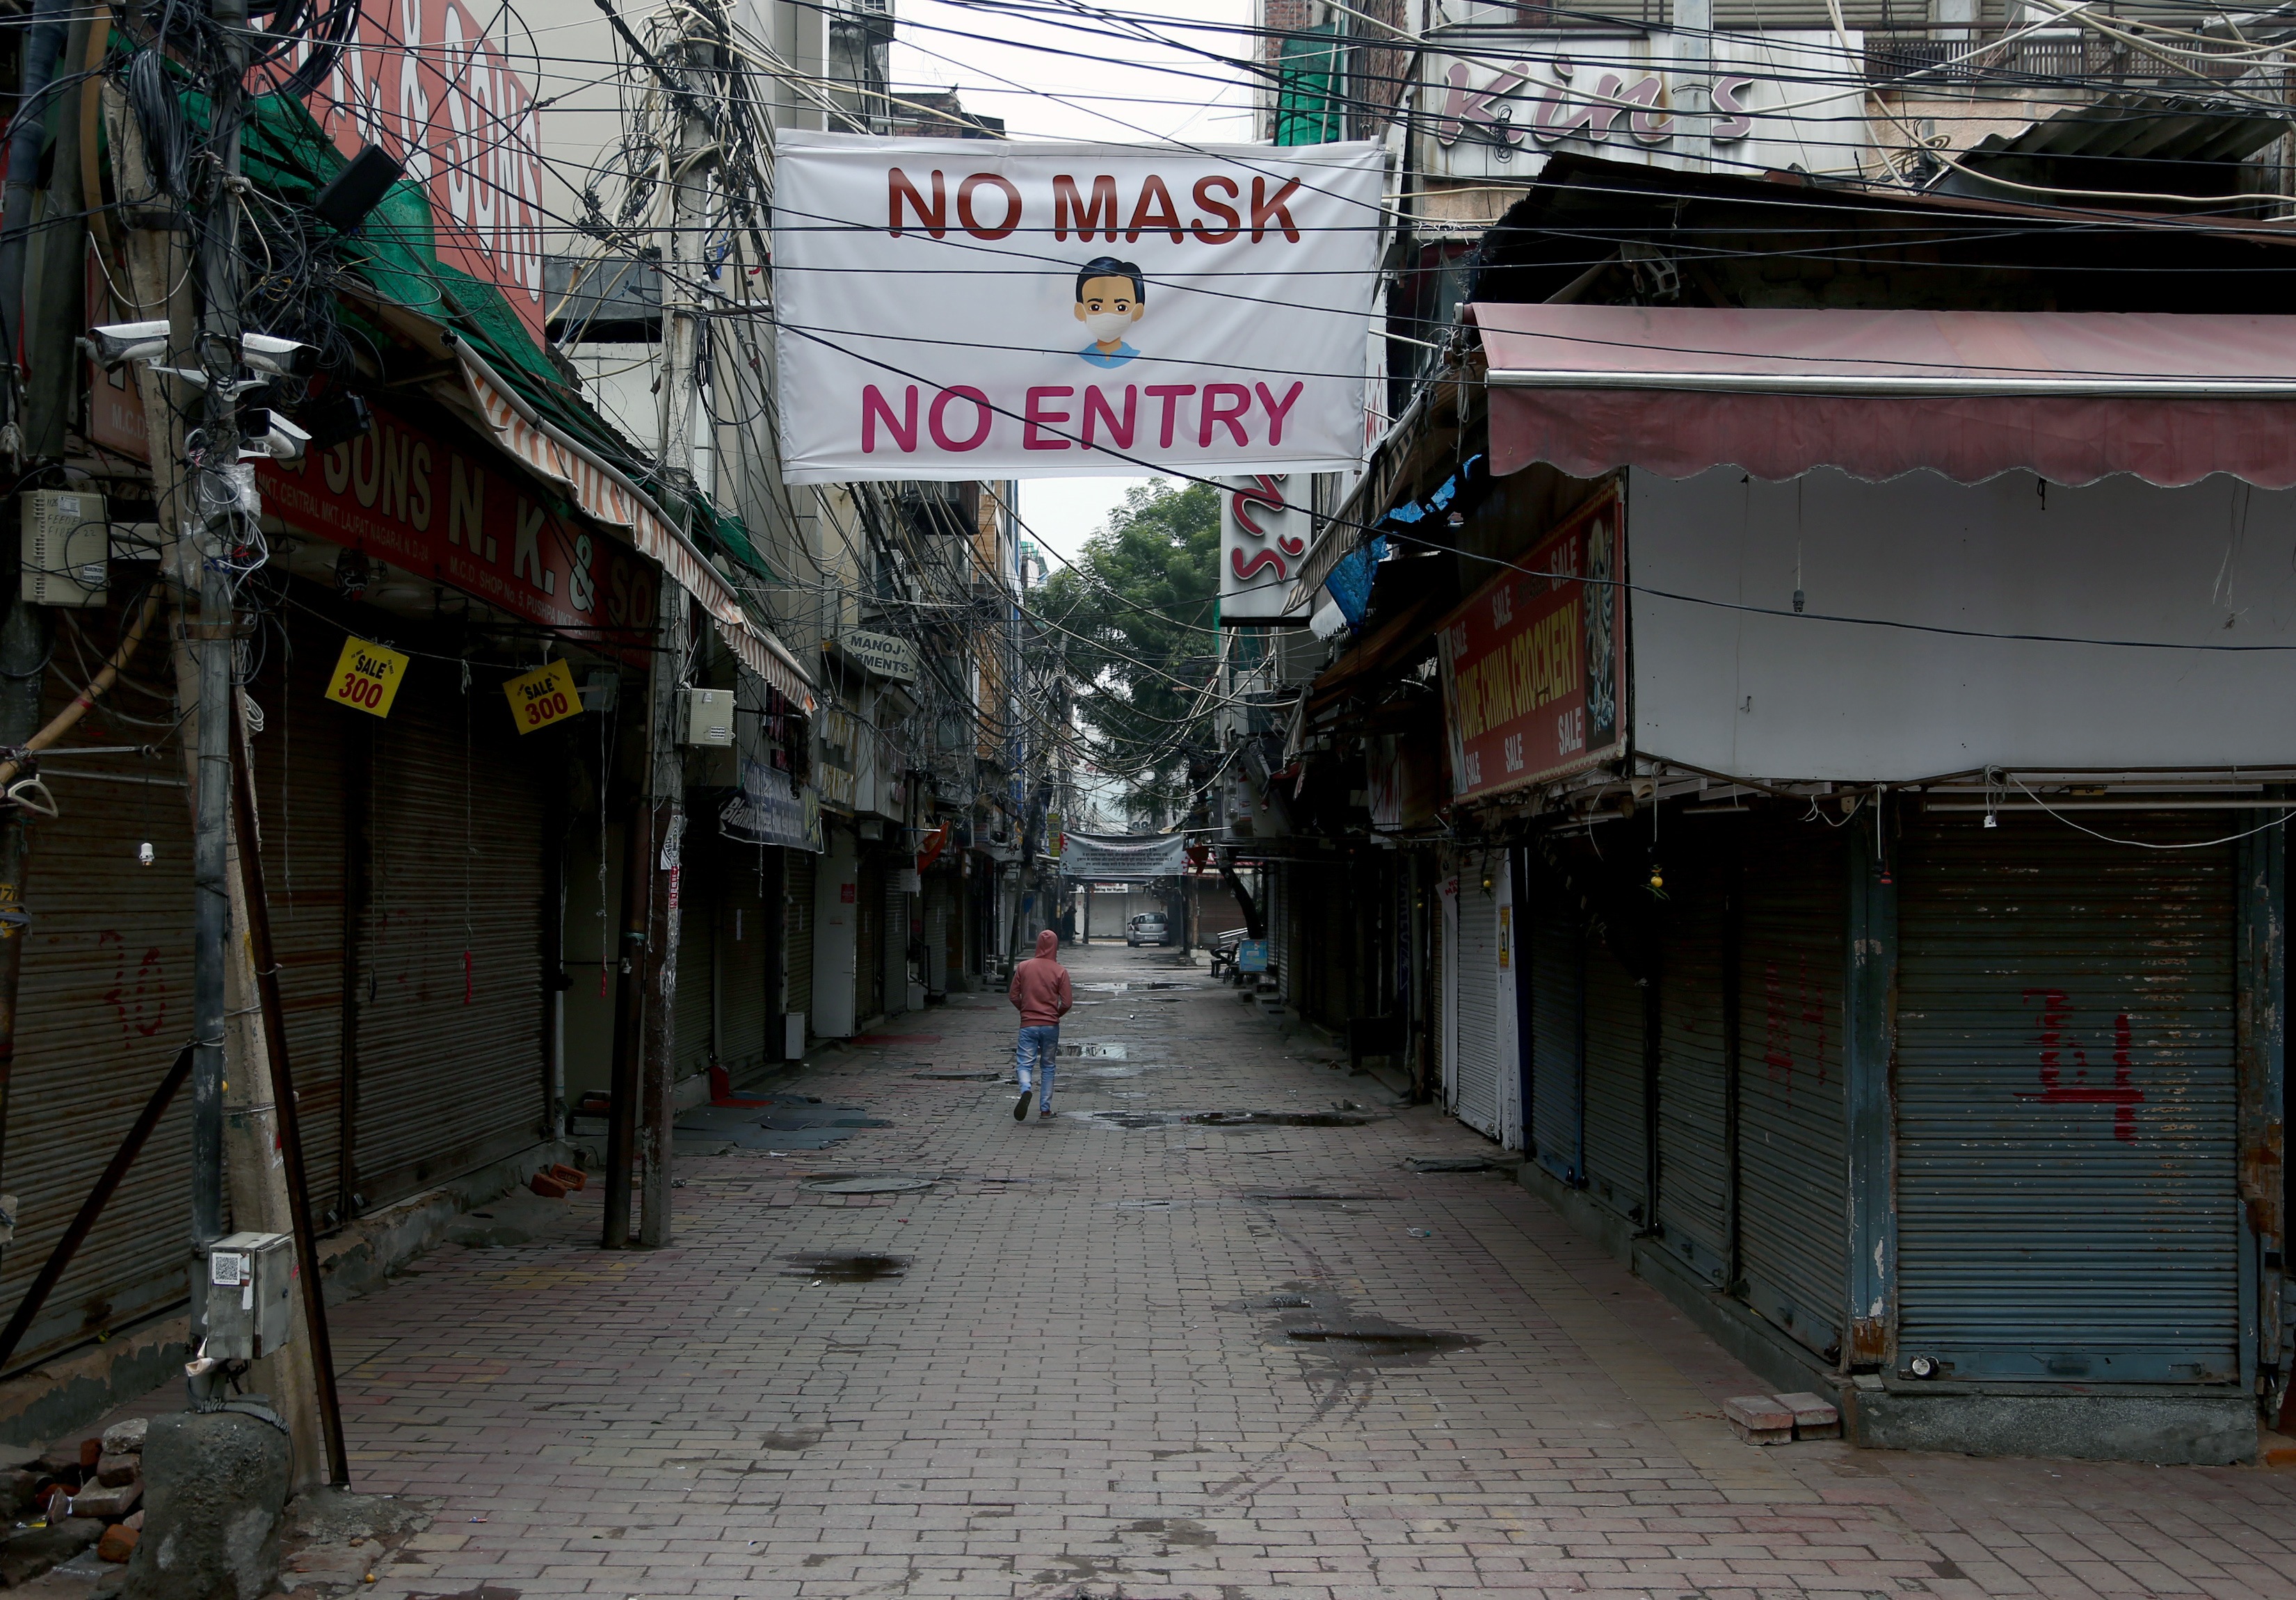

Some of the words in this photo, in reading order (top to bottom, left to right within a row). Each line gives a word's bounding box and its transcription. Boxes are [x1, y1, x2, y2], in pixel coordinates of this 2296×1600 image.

[1438, 55, 1754, 145] Kins
[444, 2, 540, 305] SONS
[888, 167, 1022, 241] NO
[1052, 174, 1302, 245] MASK
[862, 383, 993, 453] NO
[1023, 380, 1304, 451] ENTRY
[280, 480, 320, 519] CENTRAL
[321, 497, 339, 527] MKT.
[341, 508, 369, 538] LAJPAT
[323, 415, 432, 533] SONS
[449, 452, 497, 565] N.
[513, 494, 556, 597] K.
[569, 533, 596, 617] &
[607, 554, 653, 639] SO
[479, 569, 503, 597] SHOP
[504, 583, 517, 606] No.
[527, 595, 556, 624] PUSHPA
[1452, 620, 1468, 661] SALE
[1492, 584, 1514, 631] SALE
[1550, 535, 1578, 592] SALE
[338, 672, 383, 709] 300
[355, 654, 387, 680] SALE
[524, 677, 556, 701] SALE
[1481, 645, 1514, 732] CHINA
[1511, 597, 1578, 718] CROCKERY
[524, 692, 569, 725] 300
[1466, 751, 1482, 786] SALE
[1504, 732, 1524, 773] SALE
[1557, 706, 1582, 757] SALE
[1445, 885, 1459, 896] MA
